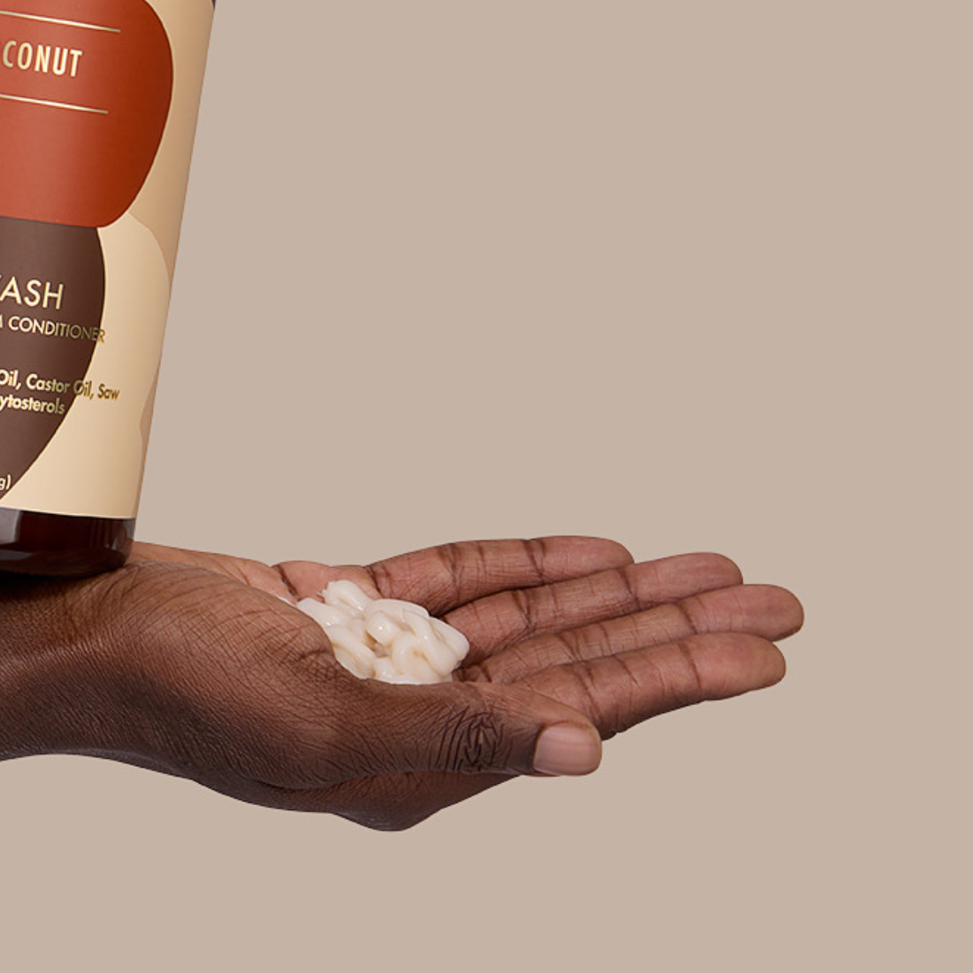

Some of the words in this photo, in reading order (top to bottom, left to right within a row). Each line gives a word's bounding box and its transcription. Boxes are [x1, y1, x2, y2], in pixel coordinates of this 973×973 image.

[8, 315, 106, 343] CONDITIONER
[26, 372, 70, 394] Castor
[73, 379, 95, 400] Oil,
[97, 384, 120, 401] Saw
